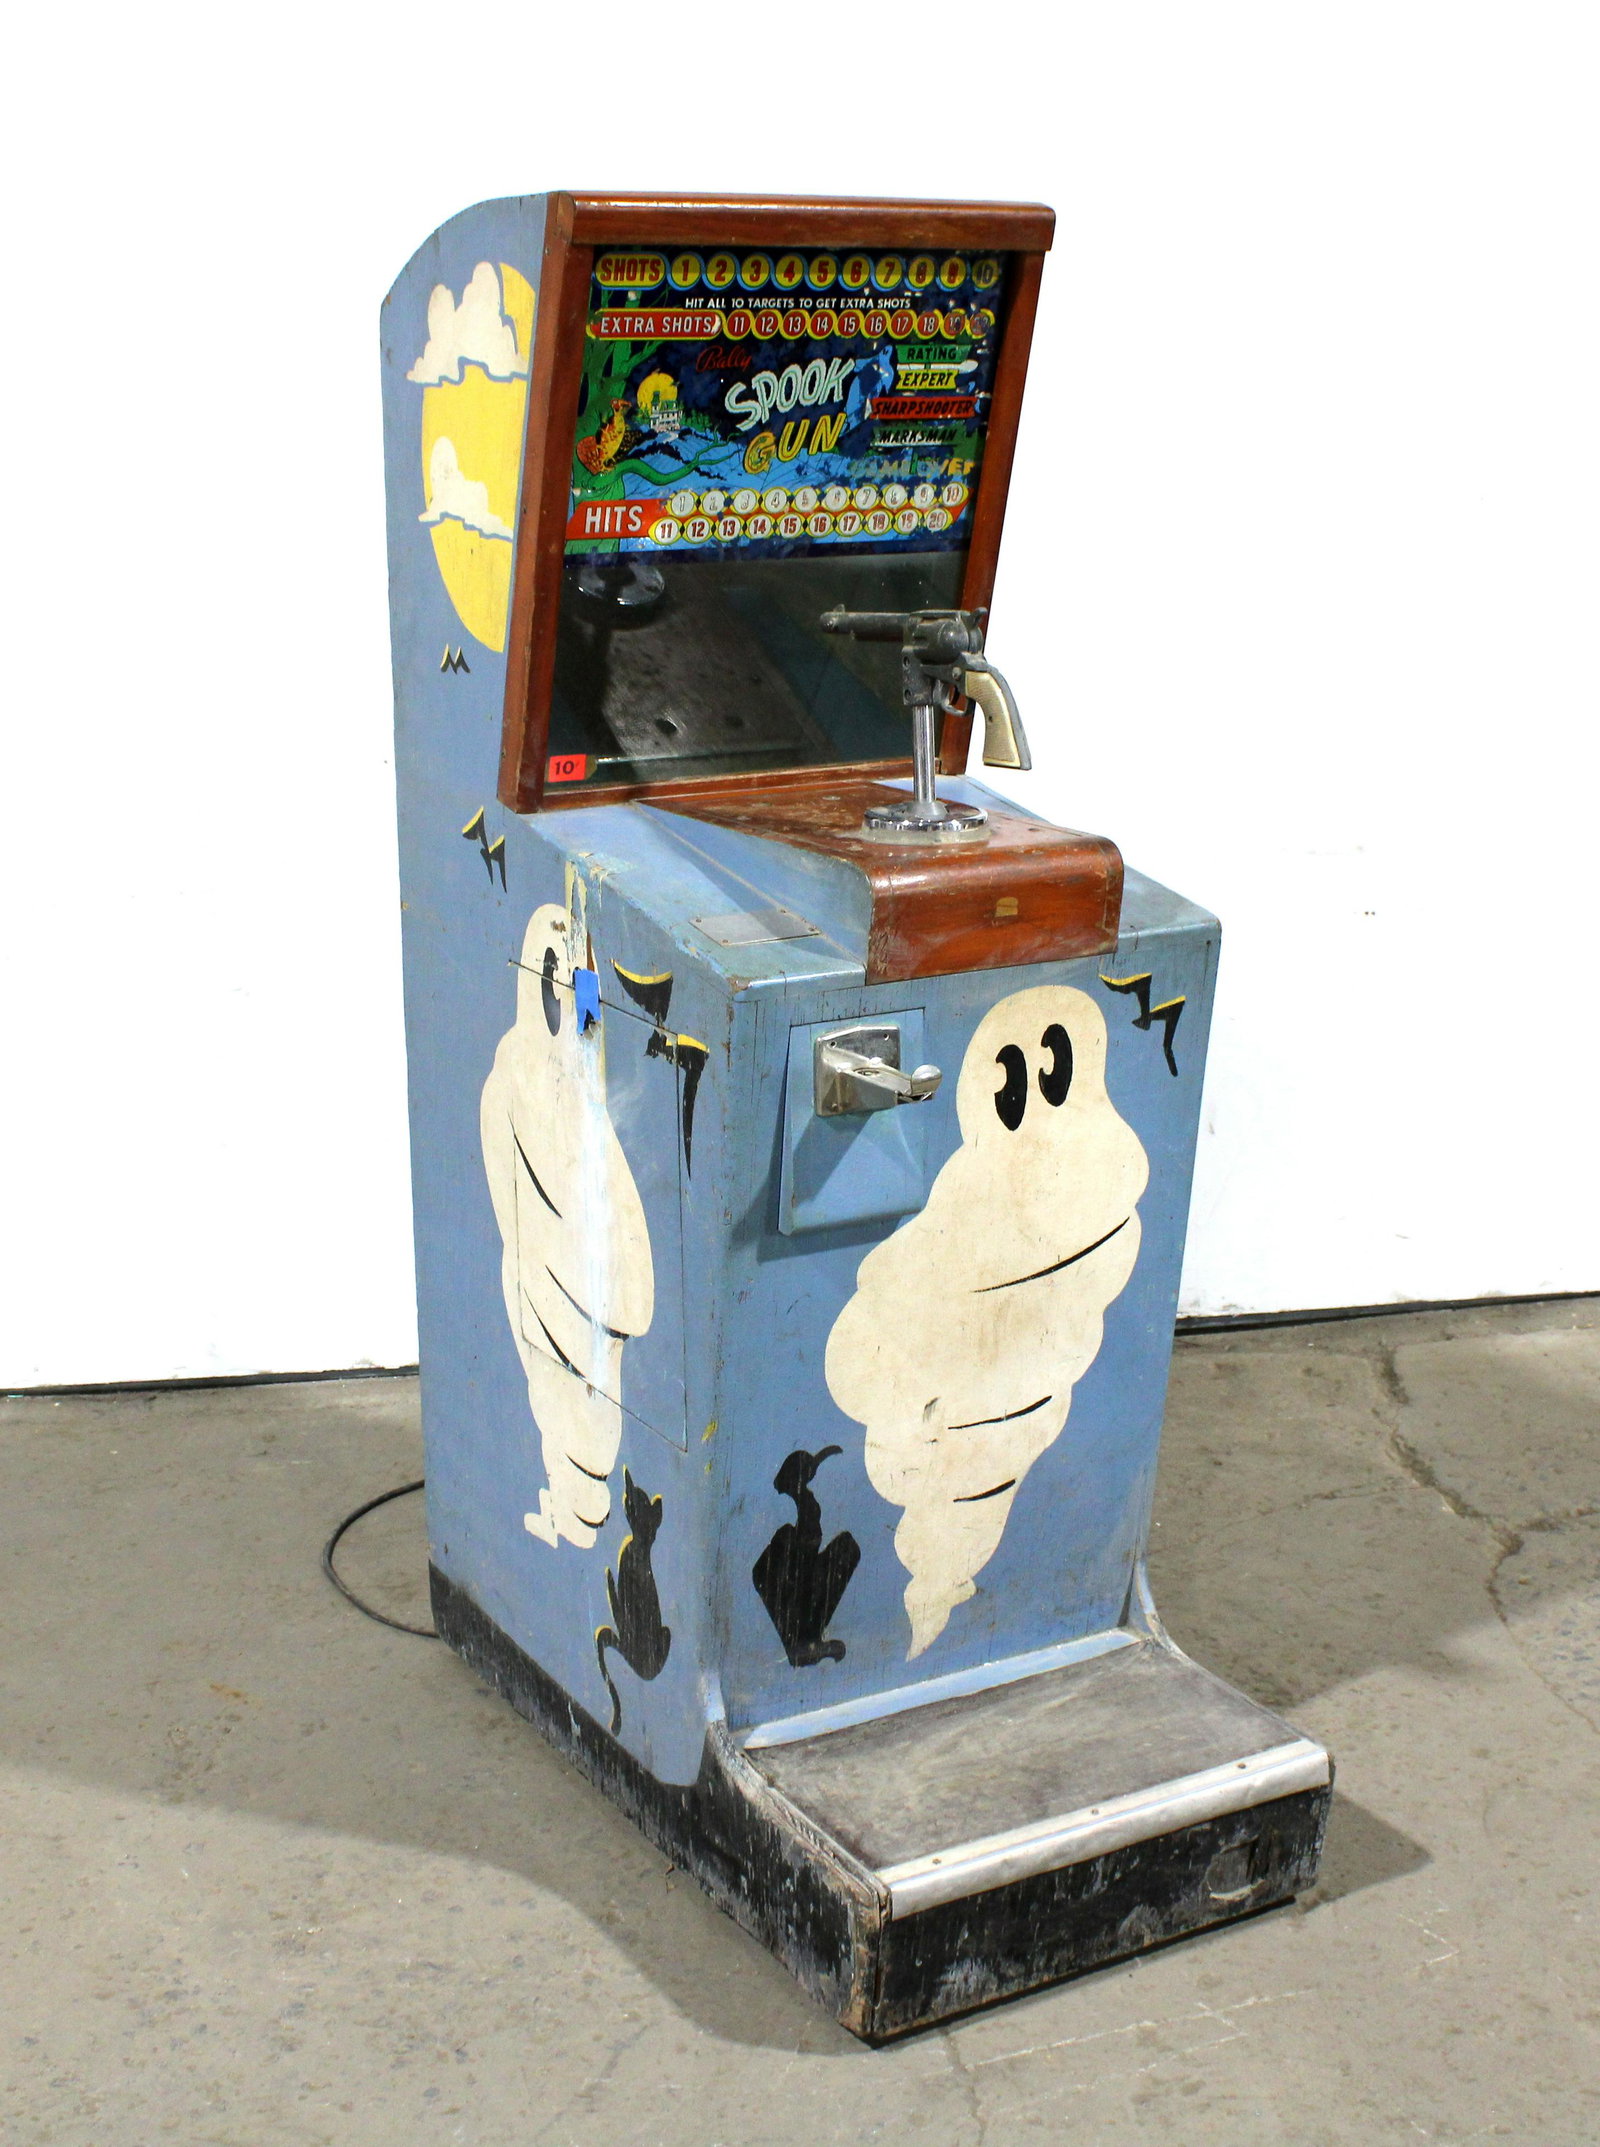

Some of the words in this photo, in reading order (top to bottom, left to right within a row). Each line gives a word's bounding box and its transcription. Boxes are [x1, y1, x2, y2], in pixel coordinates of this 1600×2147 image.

[601, 258, 661, 282] SHOTS
[681, 259, 690, 282] 1
[714, 259, 727, 282] 2
[749, 260, 762, 282] 3
[783, 260, 796, 282] 4
[816, 260, 829, 283] 5
[850, 261, 863, 283] 6
[884, 262, 895, 283] 7
[915, 262, 928, 284] 8
[977, 264, 994, 284] 10
[685, 298, 705, 309] HIT
[707, 298, 726, 309] ALL
[731, 298, 744, 309] 10
[748, 298, 795, 309] TARGETS
[800, 298, 813, 309] TO
[816, 298, 836, 309] GET
[840, 298, 875, 309] EXTRA
[877, 298, 911, 309] SHOTS
[601, 317, 656, 333] EXTRA
[662, 316, 712, 333] SHOTS
[733, 317, 745, 333] 11
[761, 317, 773, 333] 12
[788, 317, 801, 333] 13
[816, 317, 829, 332] 14
[843, 317, 856, 332] 15
[870, 317, 882, 332] 16
[896, 317, 909, 332] 17
[923, 317, 936, 332] 18
[696, 345, 752, 373] Bally
[907, 347, 957, 360] RATING
[902, 372, 953, 387] EXPERT
[724, 357, 856, 432] SPOOK
[873, 400, 973, 416] SHARPSHOOTER
[743, 413, 847, 475] GUN
[880, 429, 958, 444] MARKSMAN
[771, 491, 780, 508] 4
[863, 488, 871, 505] 7
[946, 486, 960, 502] 10
[584, 506, 643, 534] HITS
[660, 522, 674, 539] 11
[691, 521, 705, 537] 12
[722, 520, 736, 536] 13
[753, 519, 767, 535] 14
[784, 517, 797, 534] 15
[814, 516, 827, 532] 16
[843, 515, 857, 531] 17
[872, 514, 885, 530] 18
[901, 514, 914, 529] 19
[929, 512, 945, 529] 20
